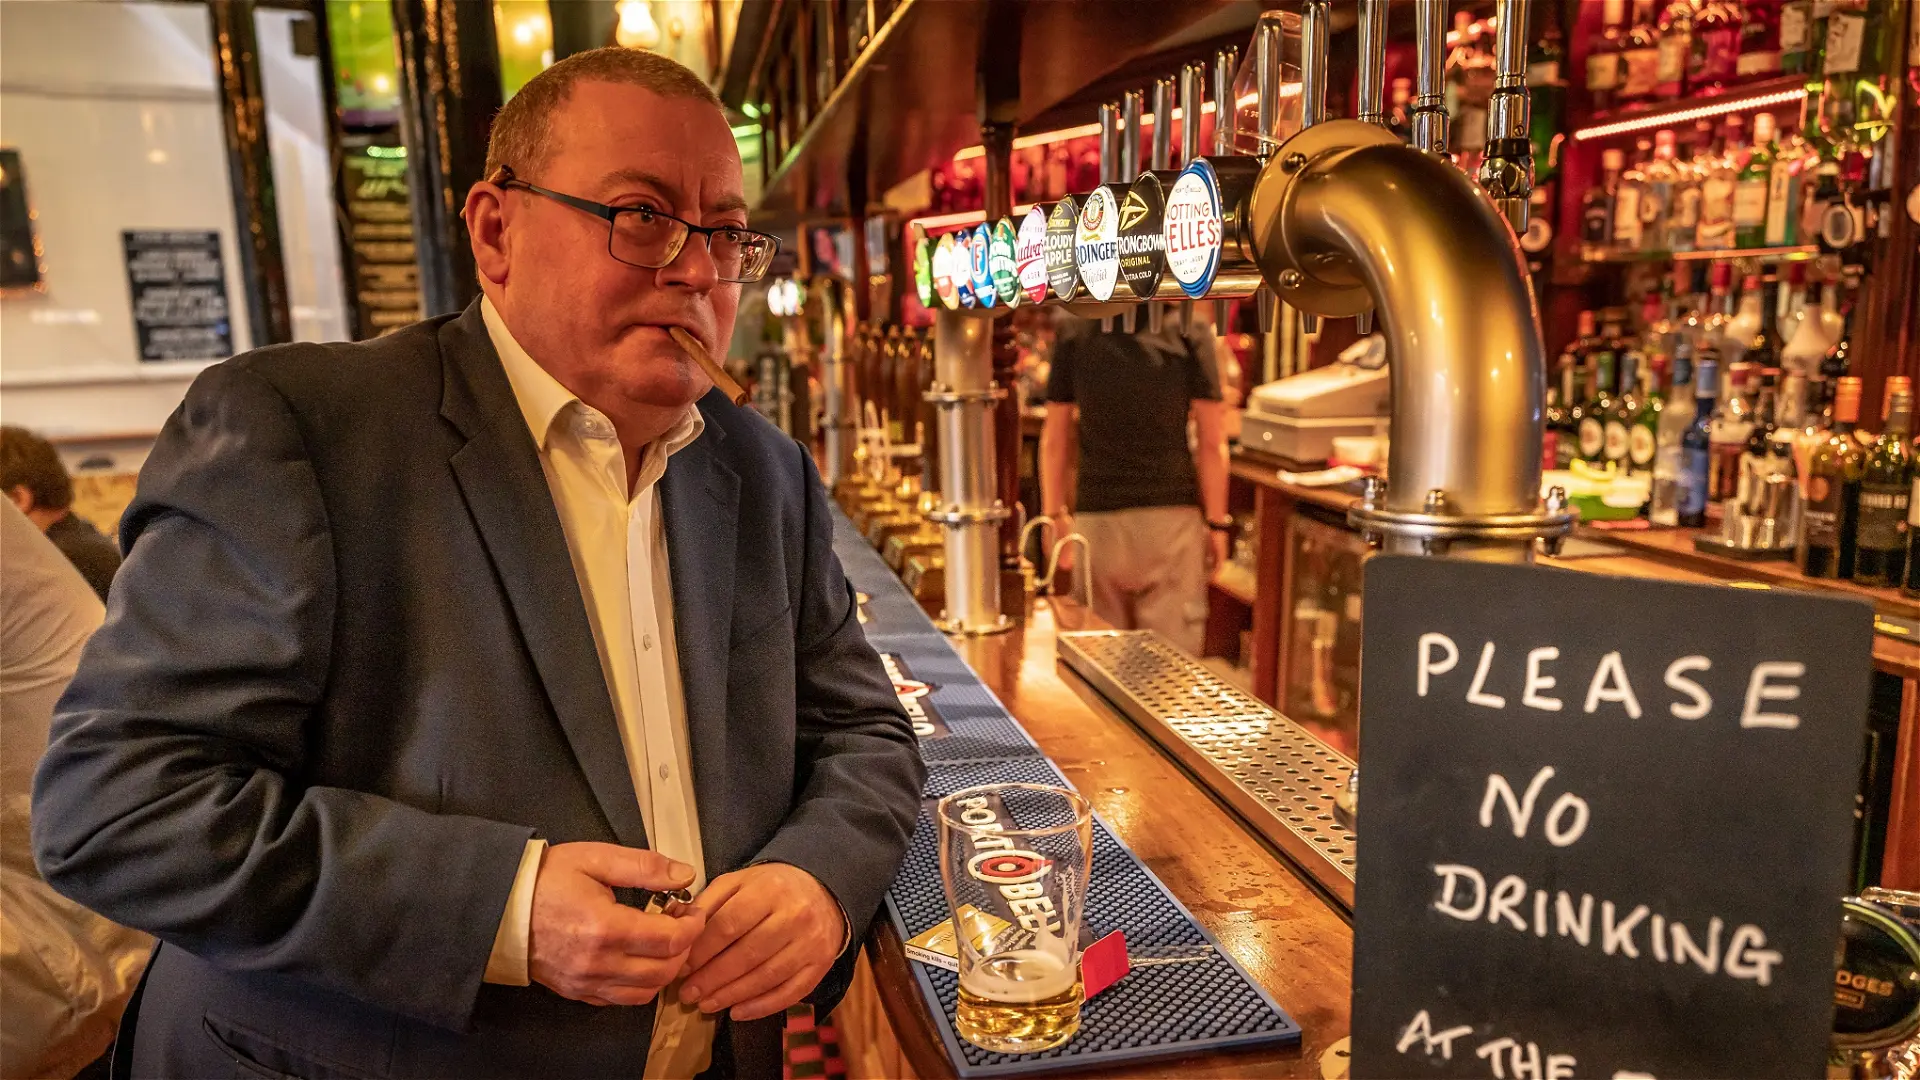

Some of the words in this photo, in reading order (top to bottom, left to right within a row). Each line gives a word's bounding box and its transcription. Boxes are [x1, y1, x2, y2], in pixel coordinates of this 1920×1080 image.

[1120, 255, 1151, 268] ORIGINAL
[1138, 270, 1152, 279] COLD
[1417, 633, 1805, 728] PLEASE
[1479, 765, 1590, 847] NO
[906, 947, 931, 961] Smoking
[931, 955, 942, 963] kills
[1433, 863, 1783, 987] DRINKING
[1396, 1009, 1474, 1060] AT
[1475, 1037, 1577, 1080] THE
